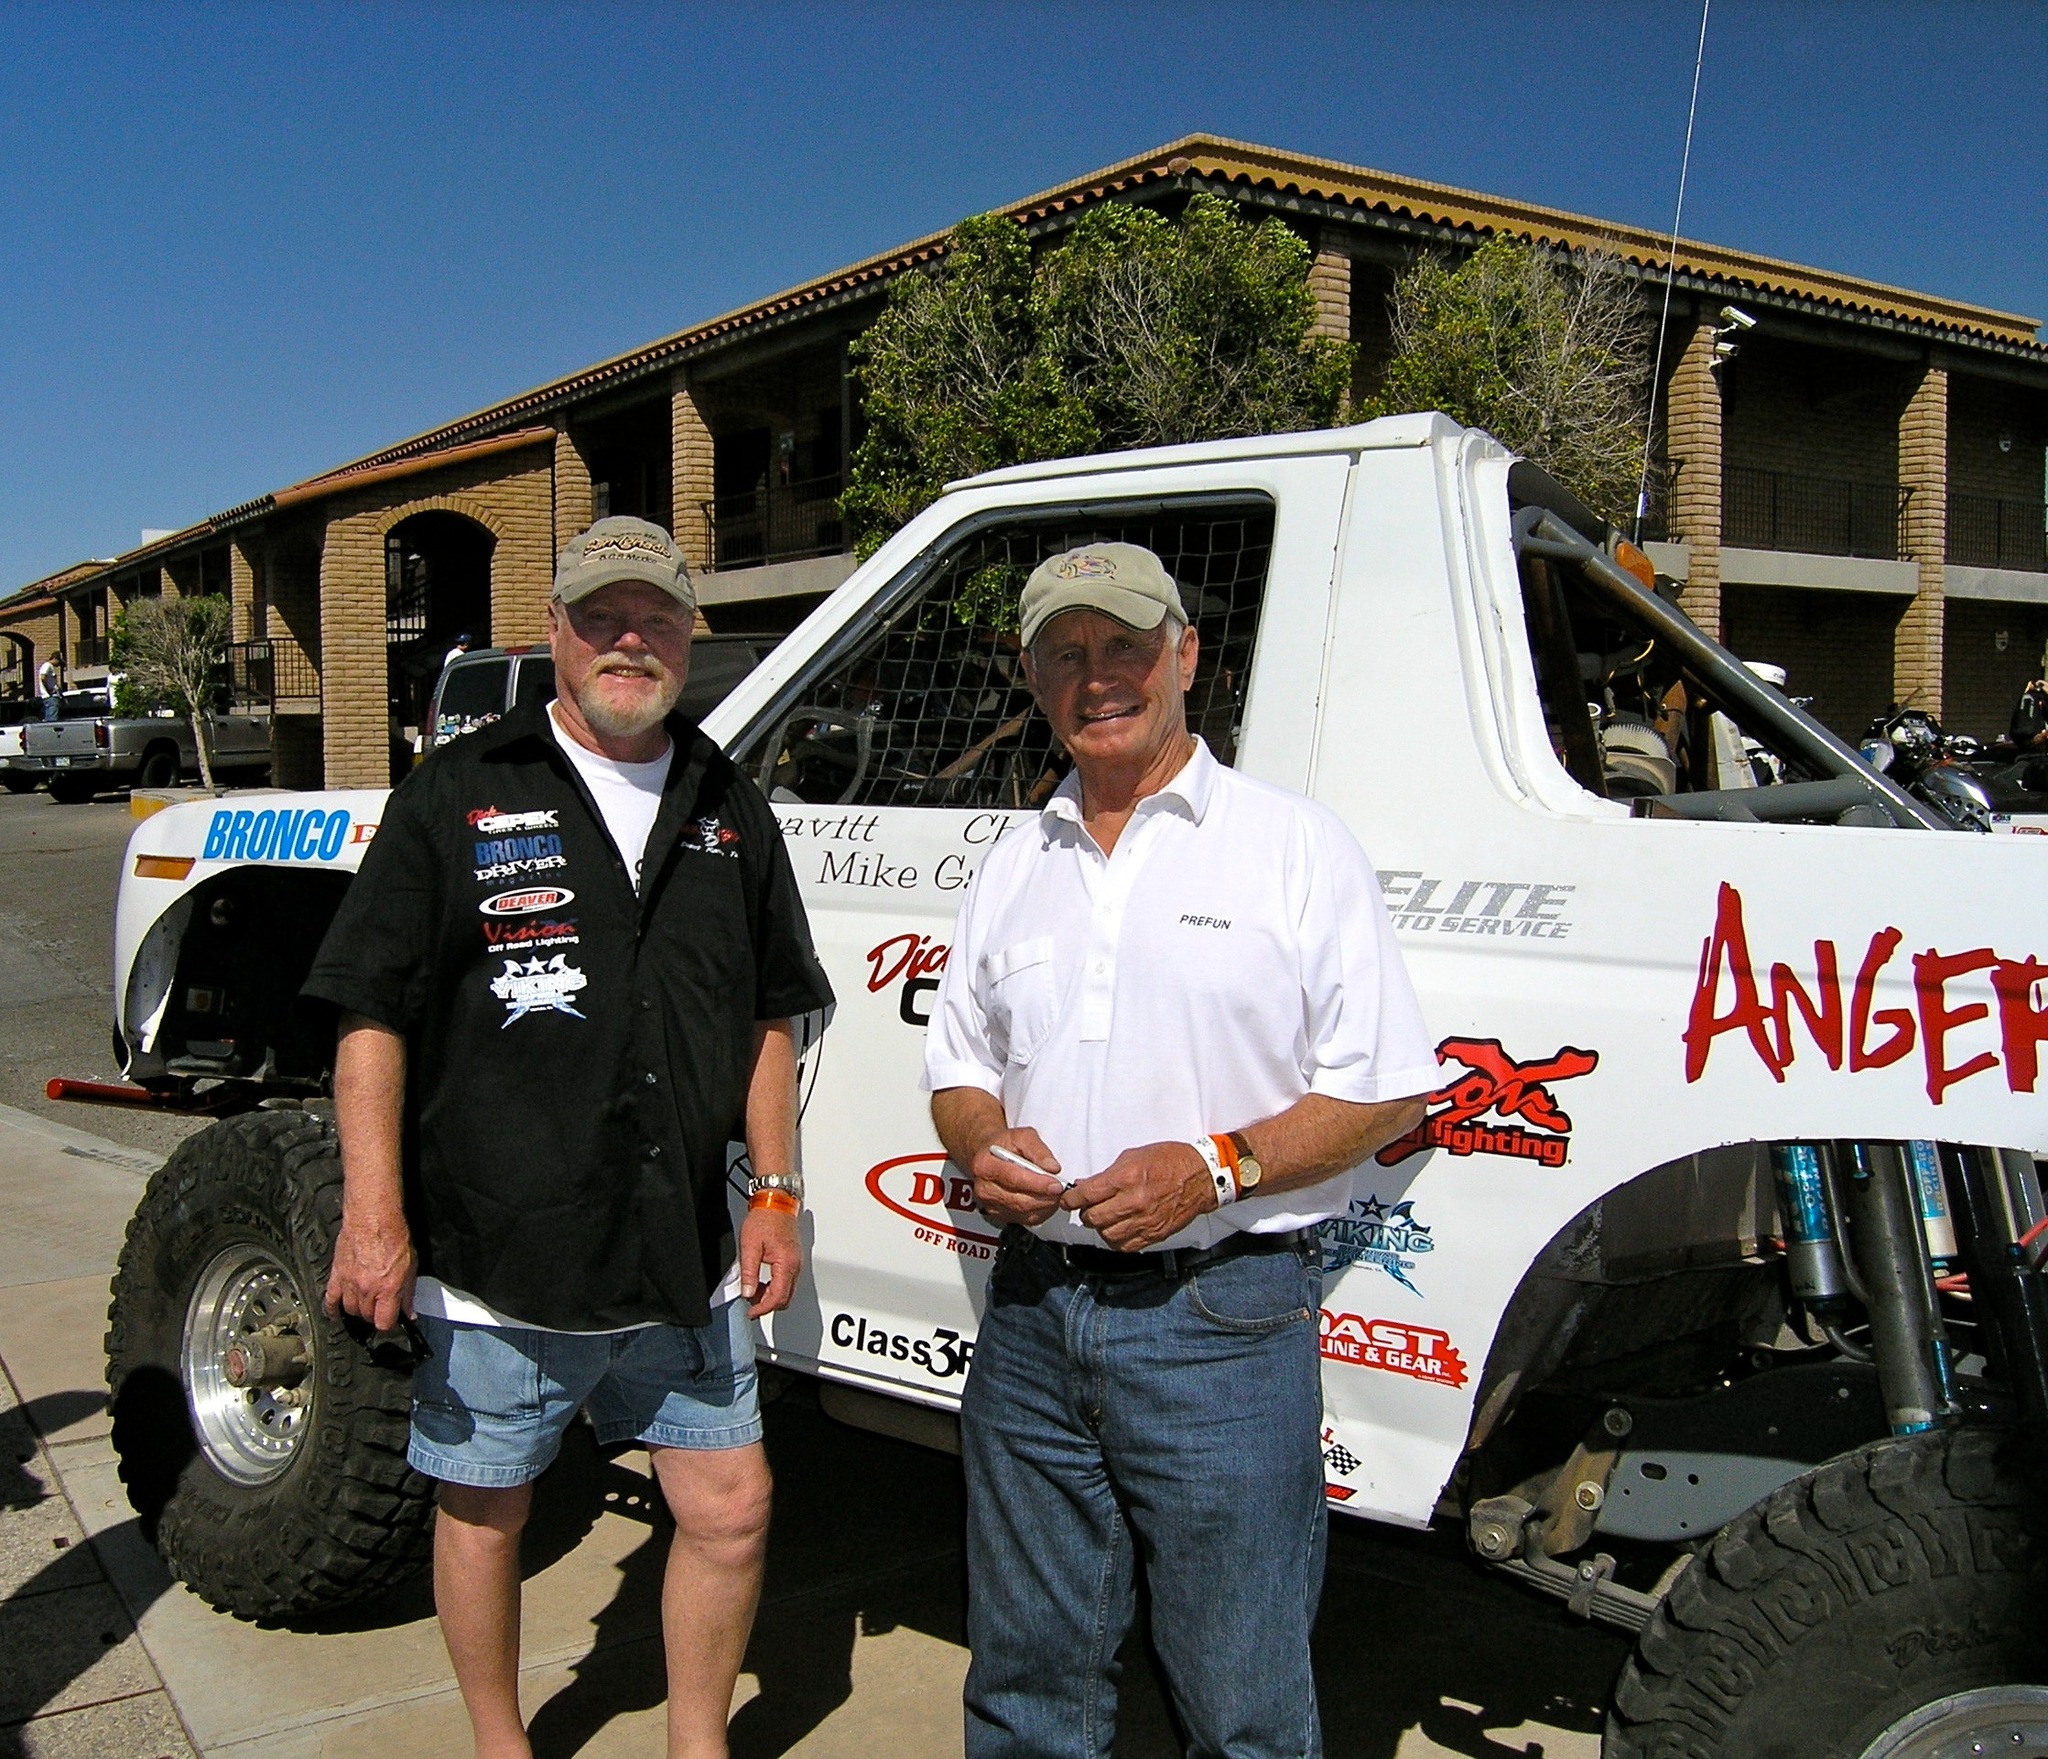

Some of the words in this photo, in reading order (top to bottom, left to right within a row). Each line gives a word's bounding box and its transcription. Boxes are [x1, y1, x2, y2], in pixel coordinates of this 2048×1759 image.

[203, 809, 350, 861] BRONCO
[477, 810, 559, 832] CEPEK
[963, 813, 1015, 845] Ch
[475, 834, 563, 865] BRONCO
[474, 855, 568, 881] DRIVER
[815, 850, 918, 889] Mike
[497, 892, 557, 910] DEAVER
[1376, 870, 1576, 920] ELITE
[483, 920, 577, 944] Vision
[1179, 914, 1232, 930] PREFUN
[1390, 914, 1437, 931] TO
[1438, 916, 1573, 939] SERVICE
[488, 944, 504, 953] Off
[506, 940, 532, 951] Road
[535, 936, 580, 947] Lighting
[867, 932, 953, 994] Dic
[490, 973, 587, 998] VIKING
[908, 1171, 977, 1213] DE
[914, 1227, 944, 1246] OFF
[946, 1238, 991, 1260] ROAD
[1313, 1219, 1435, 1253] VIKING
[1320, 1337, 1361, 1359] LINE
[1364, 1345, 1381, 1363] &
[1385, 1349, 1442, 1375] GEAR
